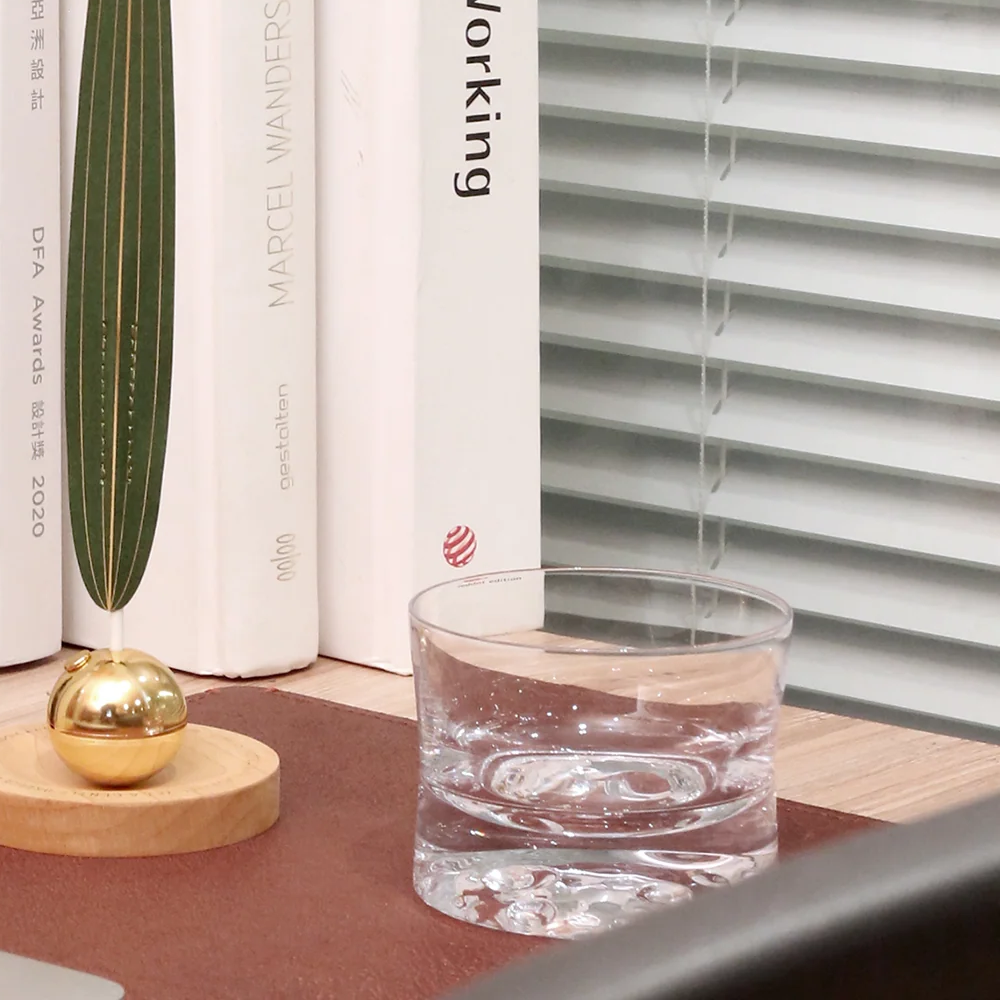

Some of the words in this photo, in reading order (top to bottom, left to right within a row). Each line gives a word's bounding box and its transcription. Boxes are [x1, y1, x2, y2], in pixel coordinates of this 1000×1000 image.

[32, 225, 46, 279] DFA
[266, 171, 295, 309] MARCEL
[32, 295, 46, 387] Awards
[280, 382, 294, 491] gestalten
[32, 475, 46, 539] 2020
